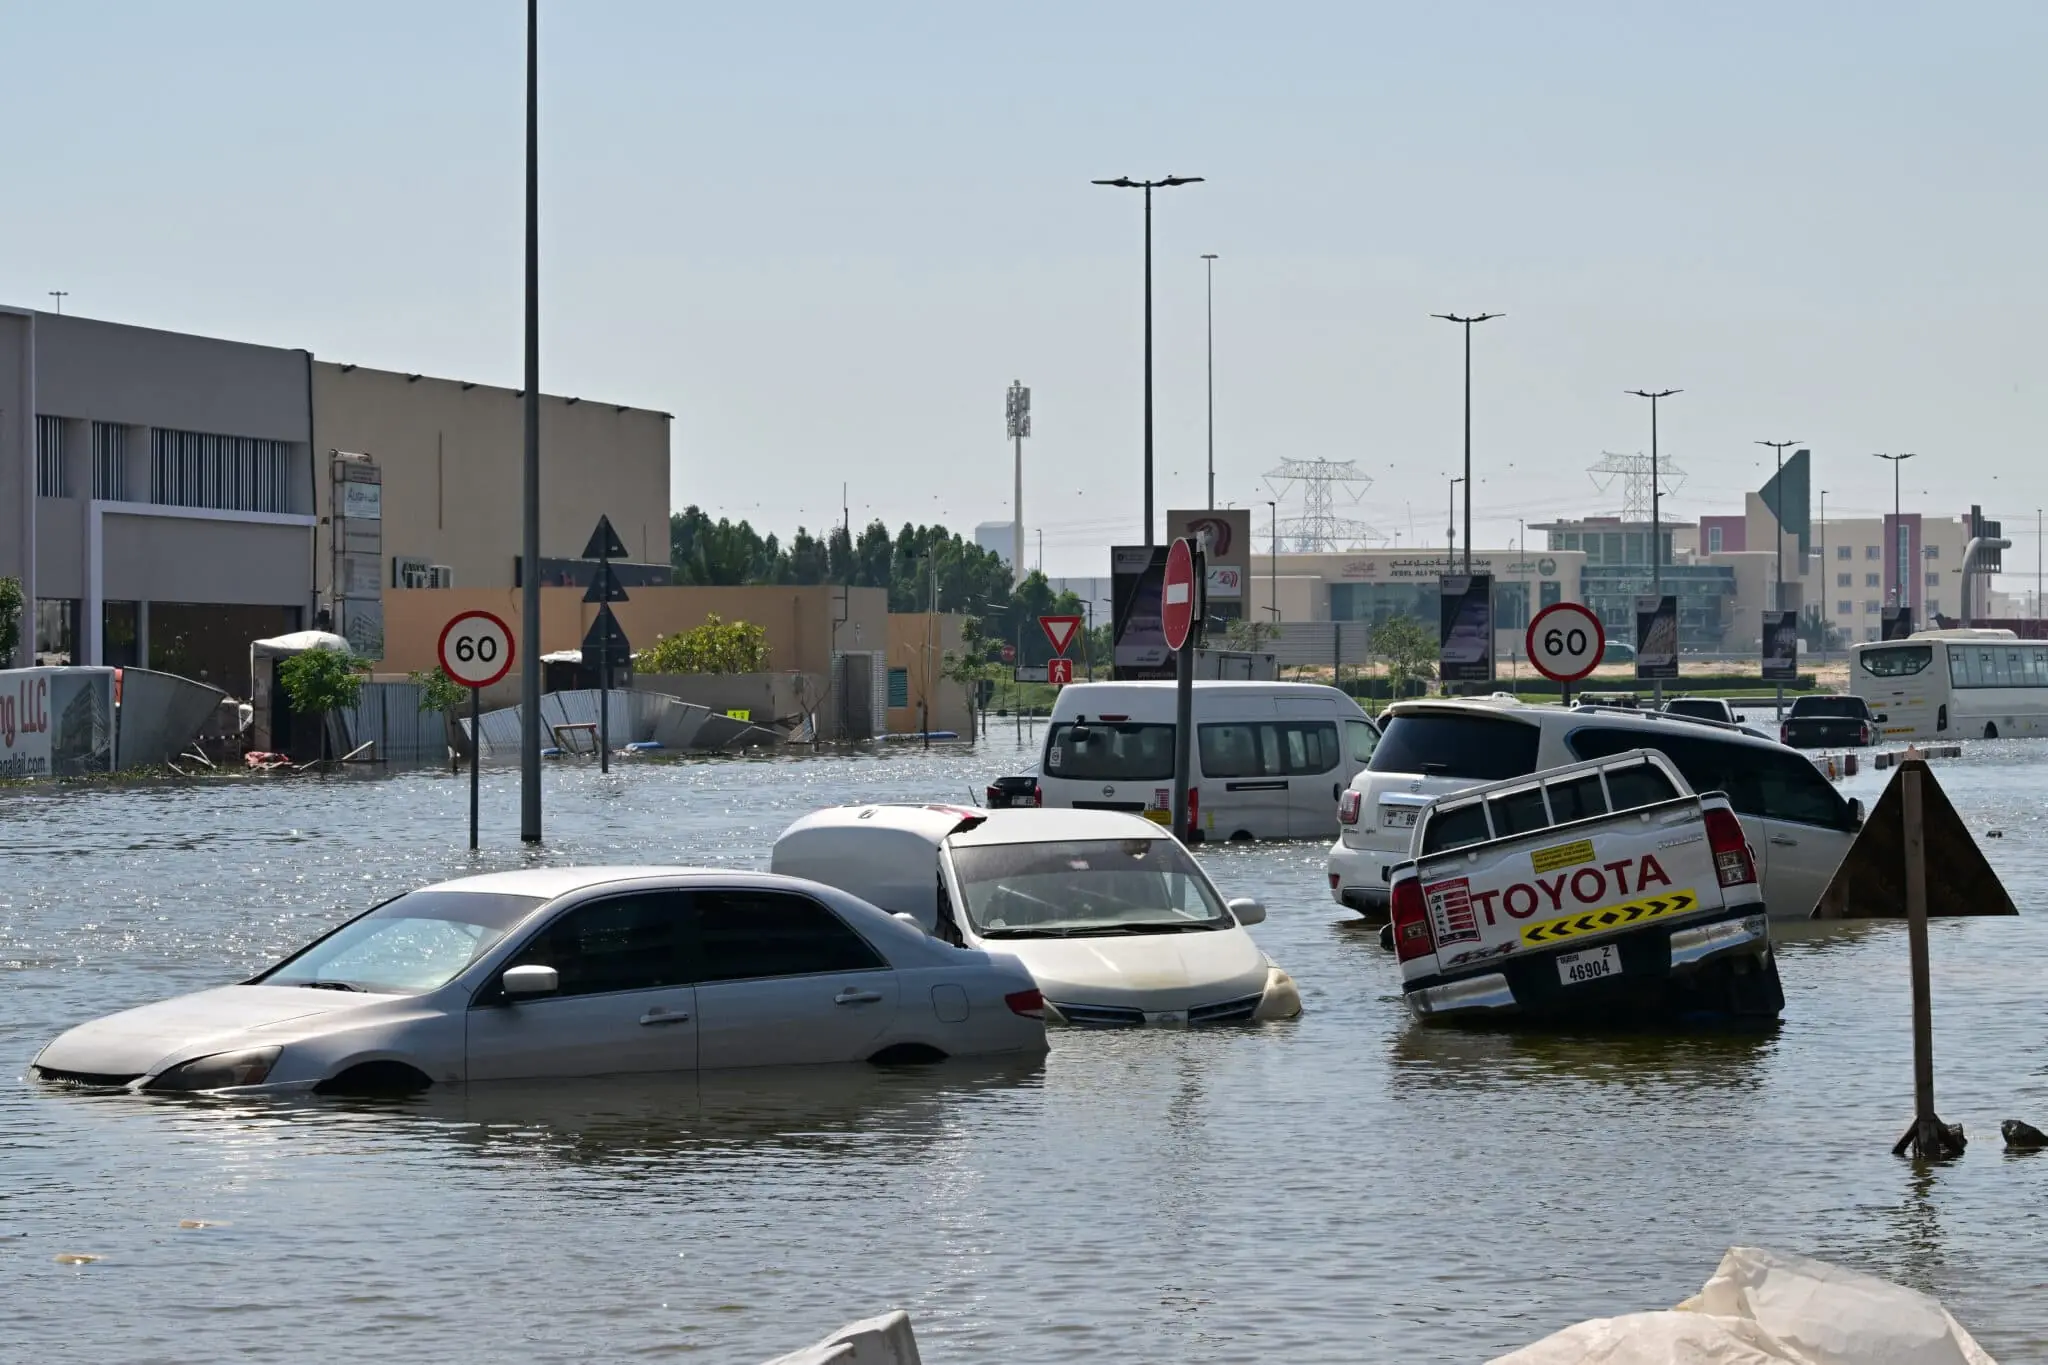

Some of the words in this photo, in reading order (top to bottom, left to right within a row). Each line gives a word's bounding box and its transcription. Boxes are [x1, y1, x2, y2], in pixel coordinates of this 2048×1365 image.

[456, 635, 497, 662] 60
[1544, 628, 1587, 656] 60
[20, 677, 47, 734] LLC
[1470, 854, 1673, 926] TOYOTA
[1601, 947, 1611, 958] Z
[1569, 959, 1610, 981] 46904
